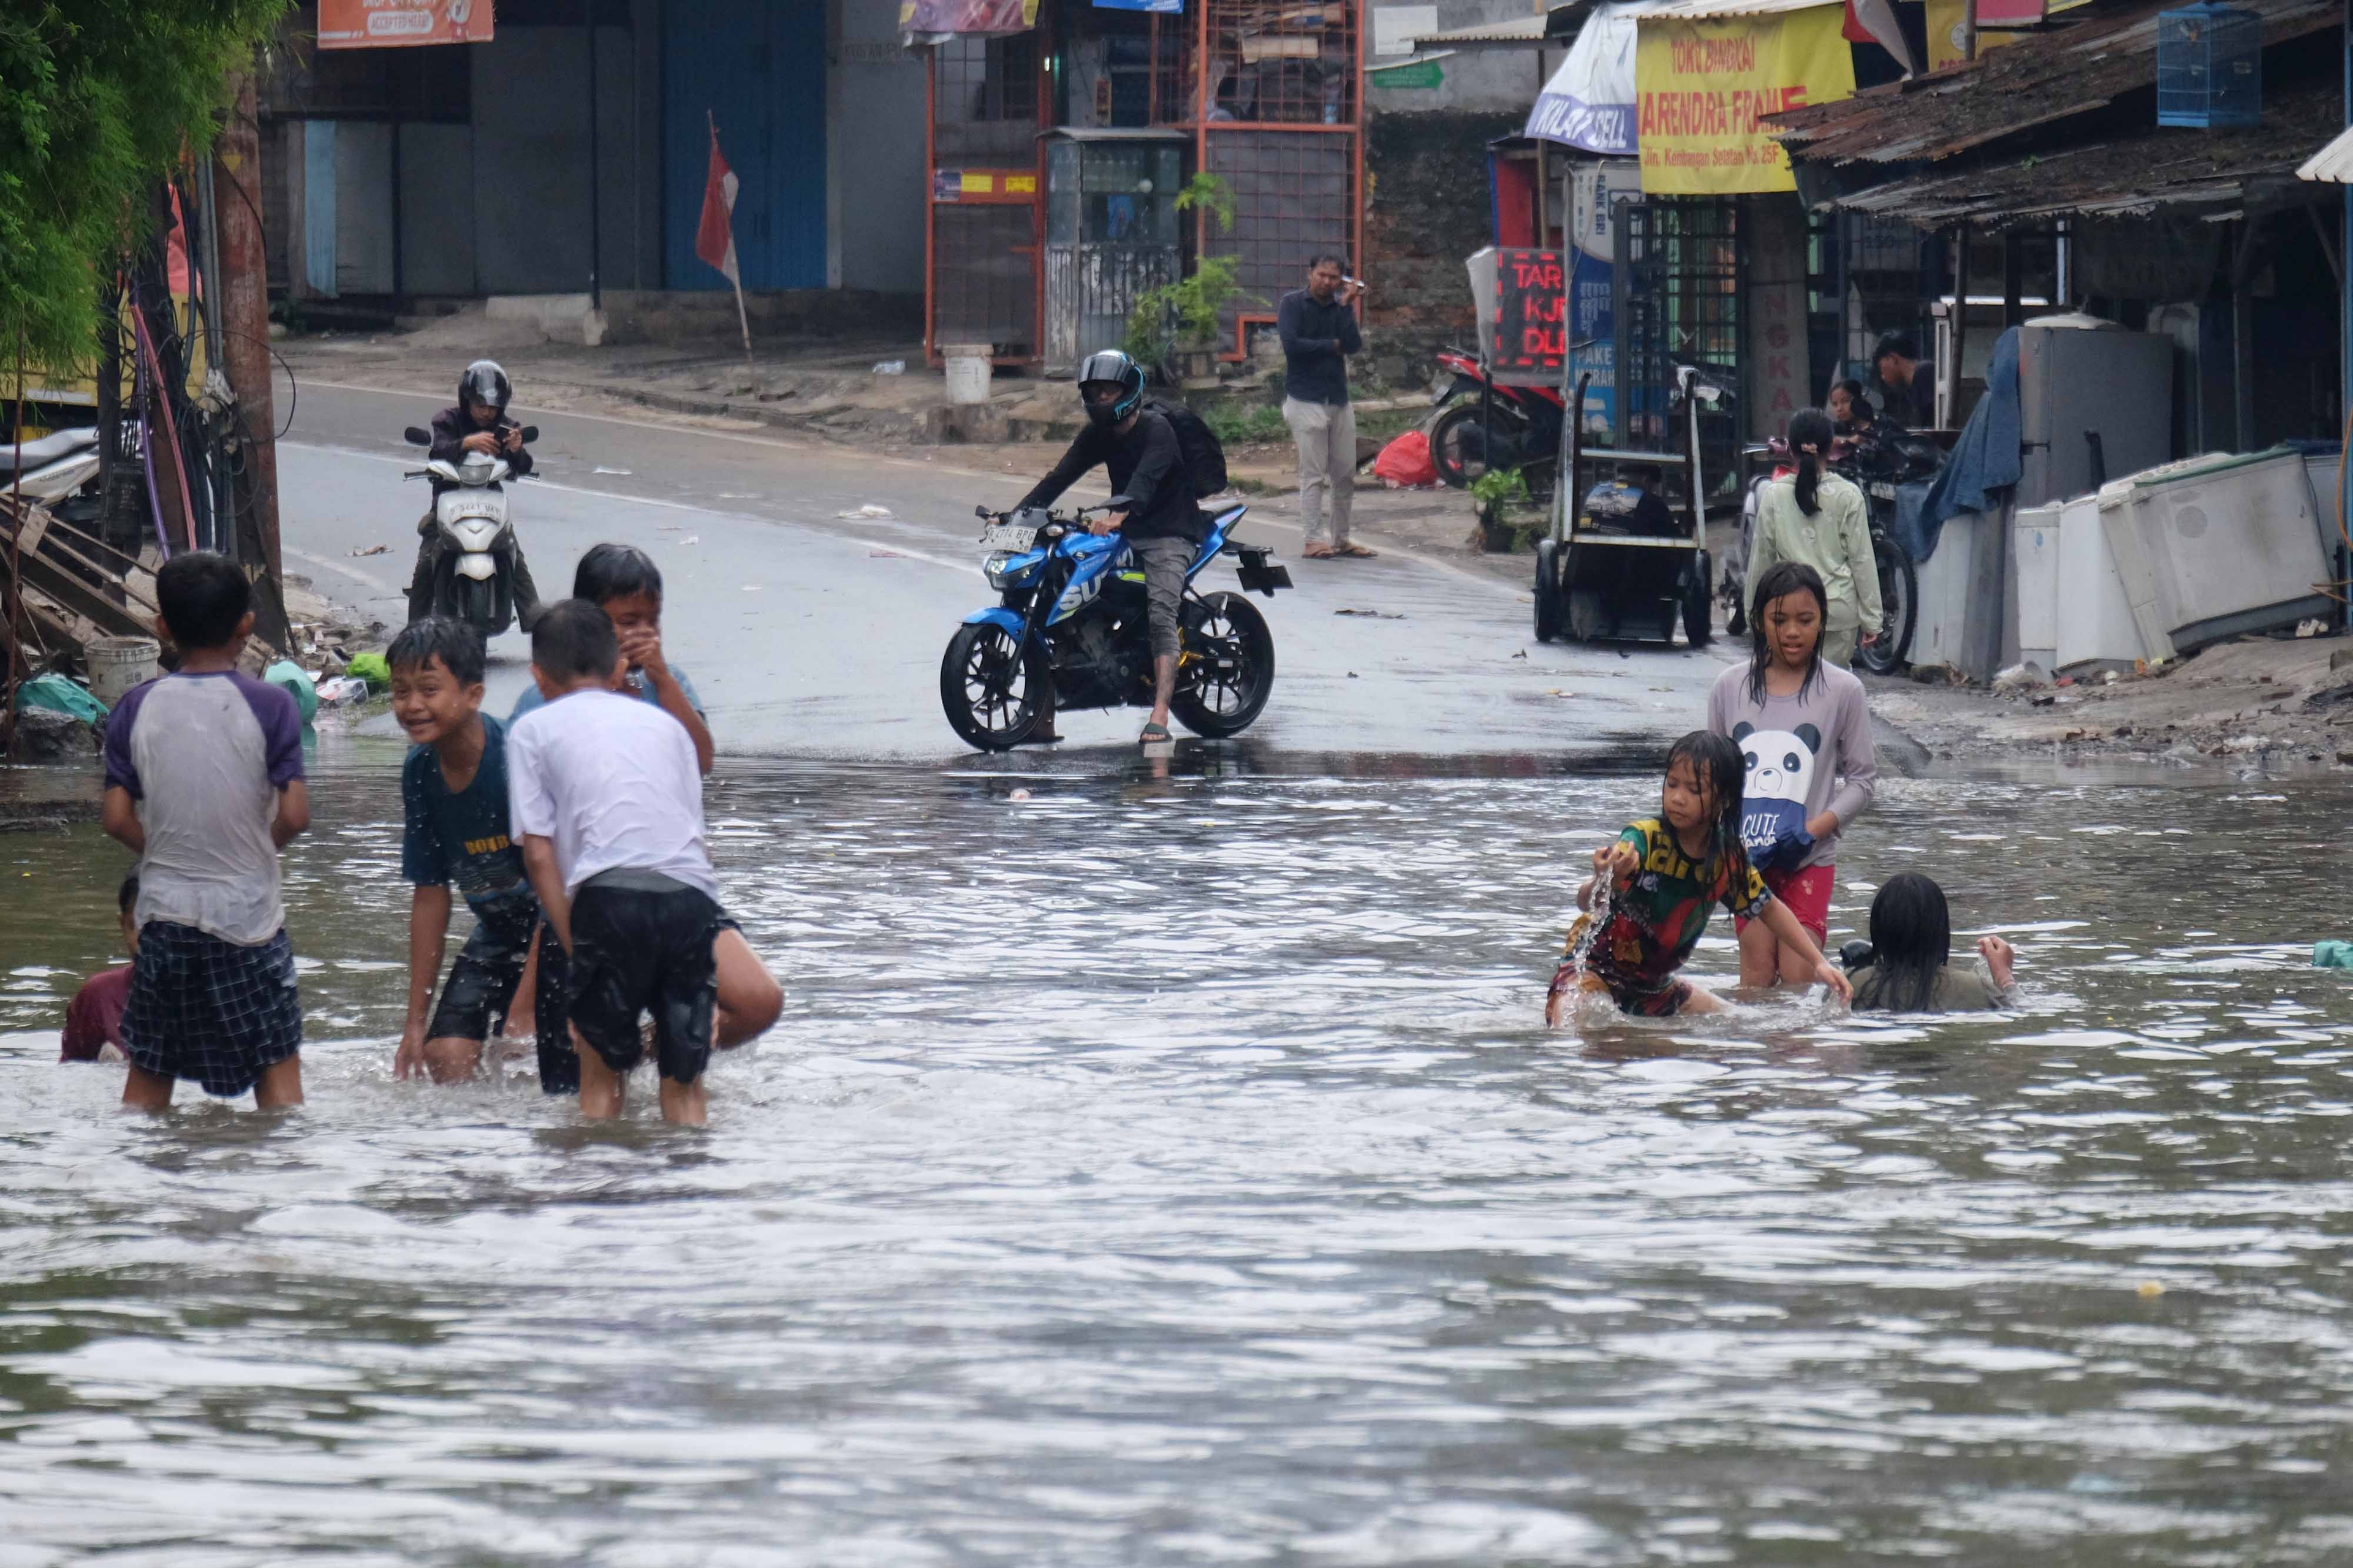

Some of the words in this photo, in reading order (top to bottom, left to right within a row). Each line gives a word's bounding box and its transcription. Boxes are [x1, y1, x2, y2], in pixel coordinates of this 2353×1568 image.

[1637, 92, 1727, 136] ARENDRA
[1665, 147, 1710, 171] Kembangan
[1713, 148, 1745, 166] Selatan
[1596, 214, 1606, 235] BRI
[1743, 814, 1779, 840] CUTE
